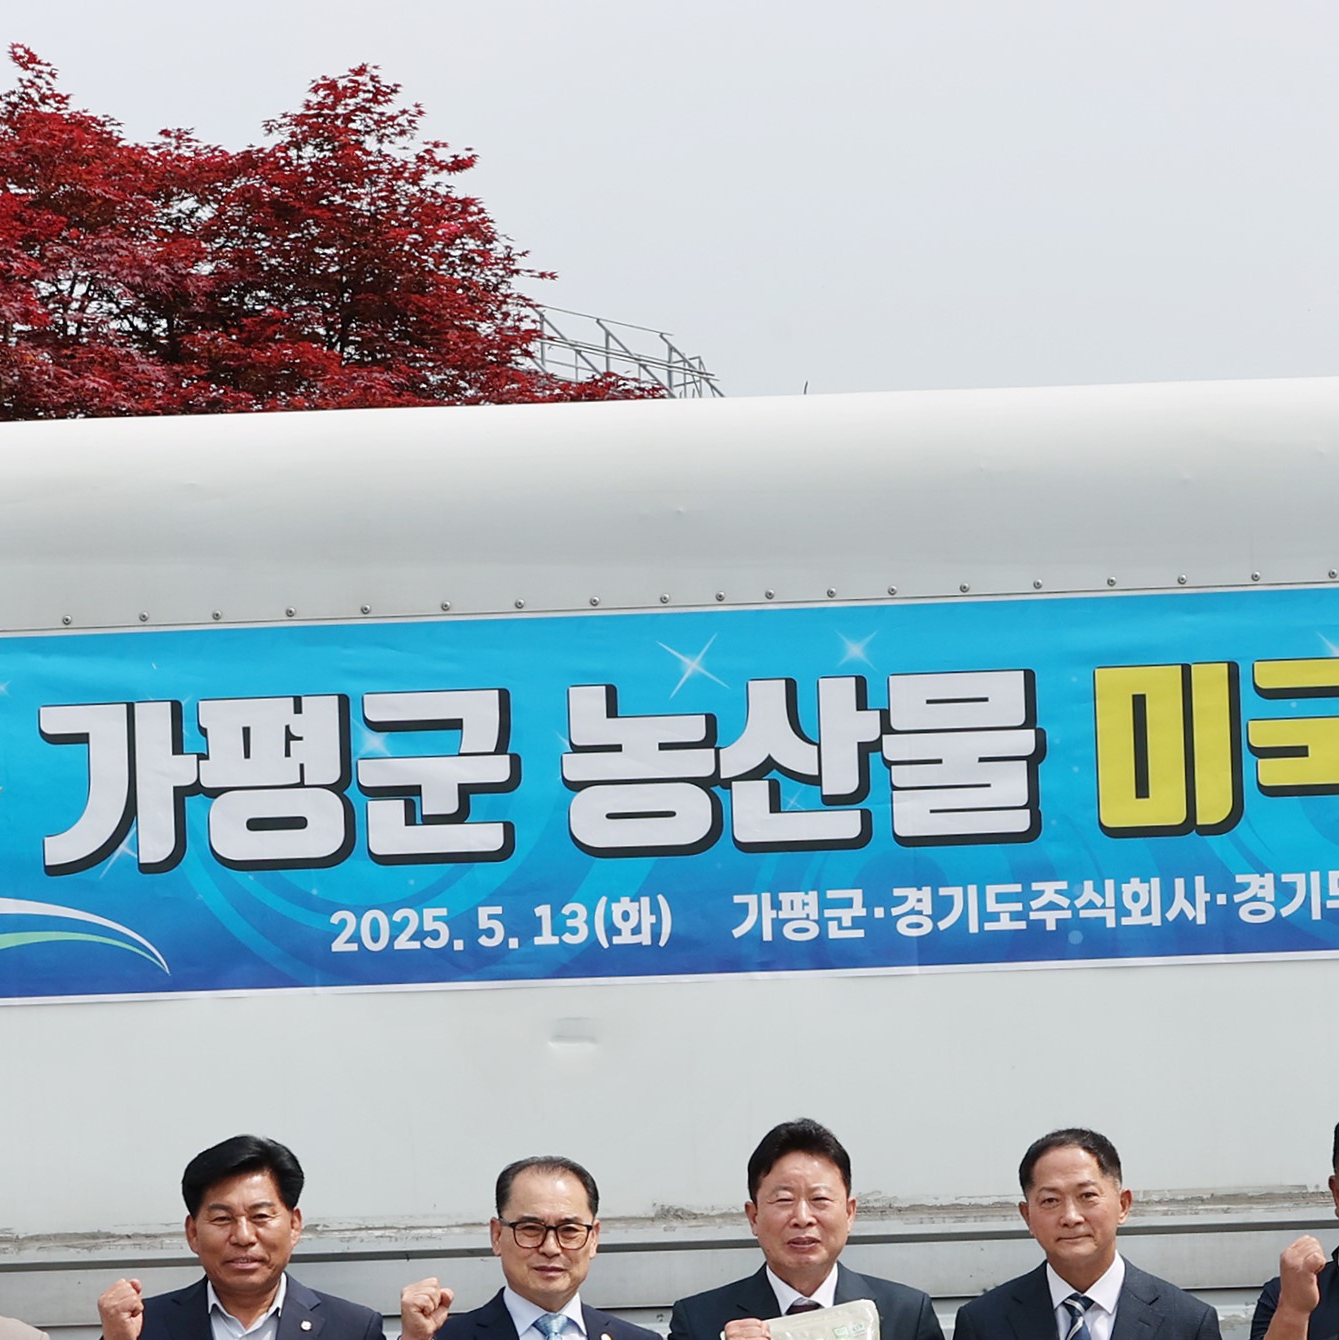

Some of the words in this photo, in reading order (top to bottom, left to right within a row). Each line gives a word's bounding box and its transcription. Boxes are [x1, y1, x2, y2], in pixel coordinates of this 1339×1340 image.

[38, 686, 522, 877] 가평군
[561, 667, 1047, 858] 농산물
[329, 906, 464, 954] 2025.
[476, 903, 521, 951] 5.
[533, 893, 672, 949] 13(화)
